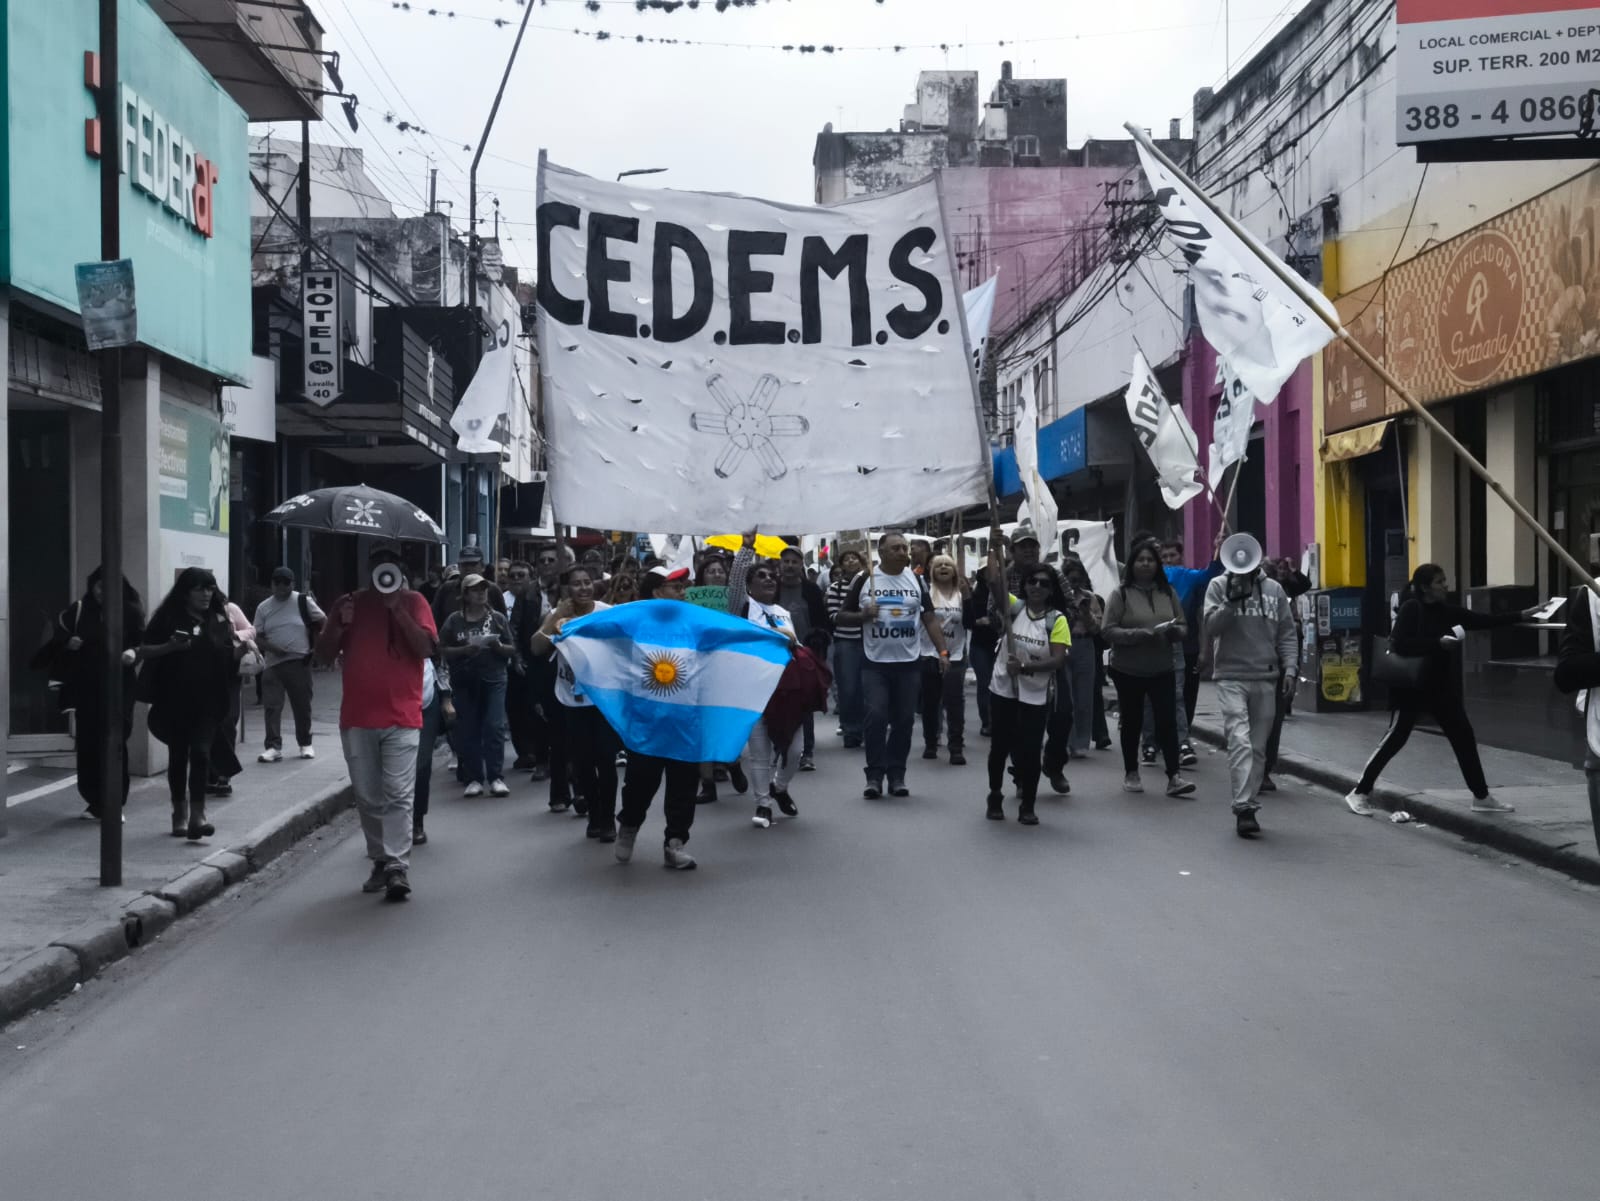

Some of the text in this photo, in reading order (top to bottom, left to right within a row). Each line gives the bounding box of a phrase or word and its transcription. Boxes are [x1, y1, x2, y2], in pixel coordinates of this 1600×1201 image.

[1419, 36, 1465, 50] LOCAL
[1469, 29, 1552, 46] COMERCIAL
[1432, 48, 1600, 75] SUP. TERR. 200 M2
[1405, 103, 1460, 131] 388
[1490, 100, 1509, 124] 4
[1441, 243, 1518, 316] PANIFICADORA
[306, 276, 334, 354] HOTEL
[1451, 315, 1508, 370] Granada
[312, 389, 331, 398] 40
[1332, 607, 1360, 617] SUBE
[872, 627, 916, 639] LUCHA
